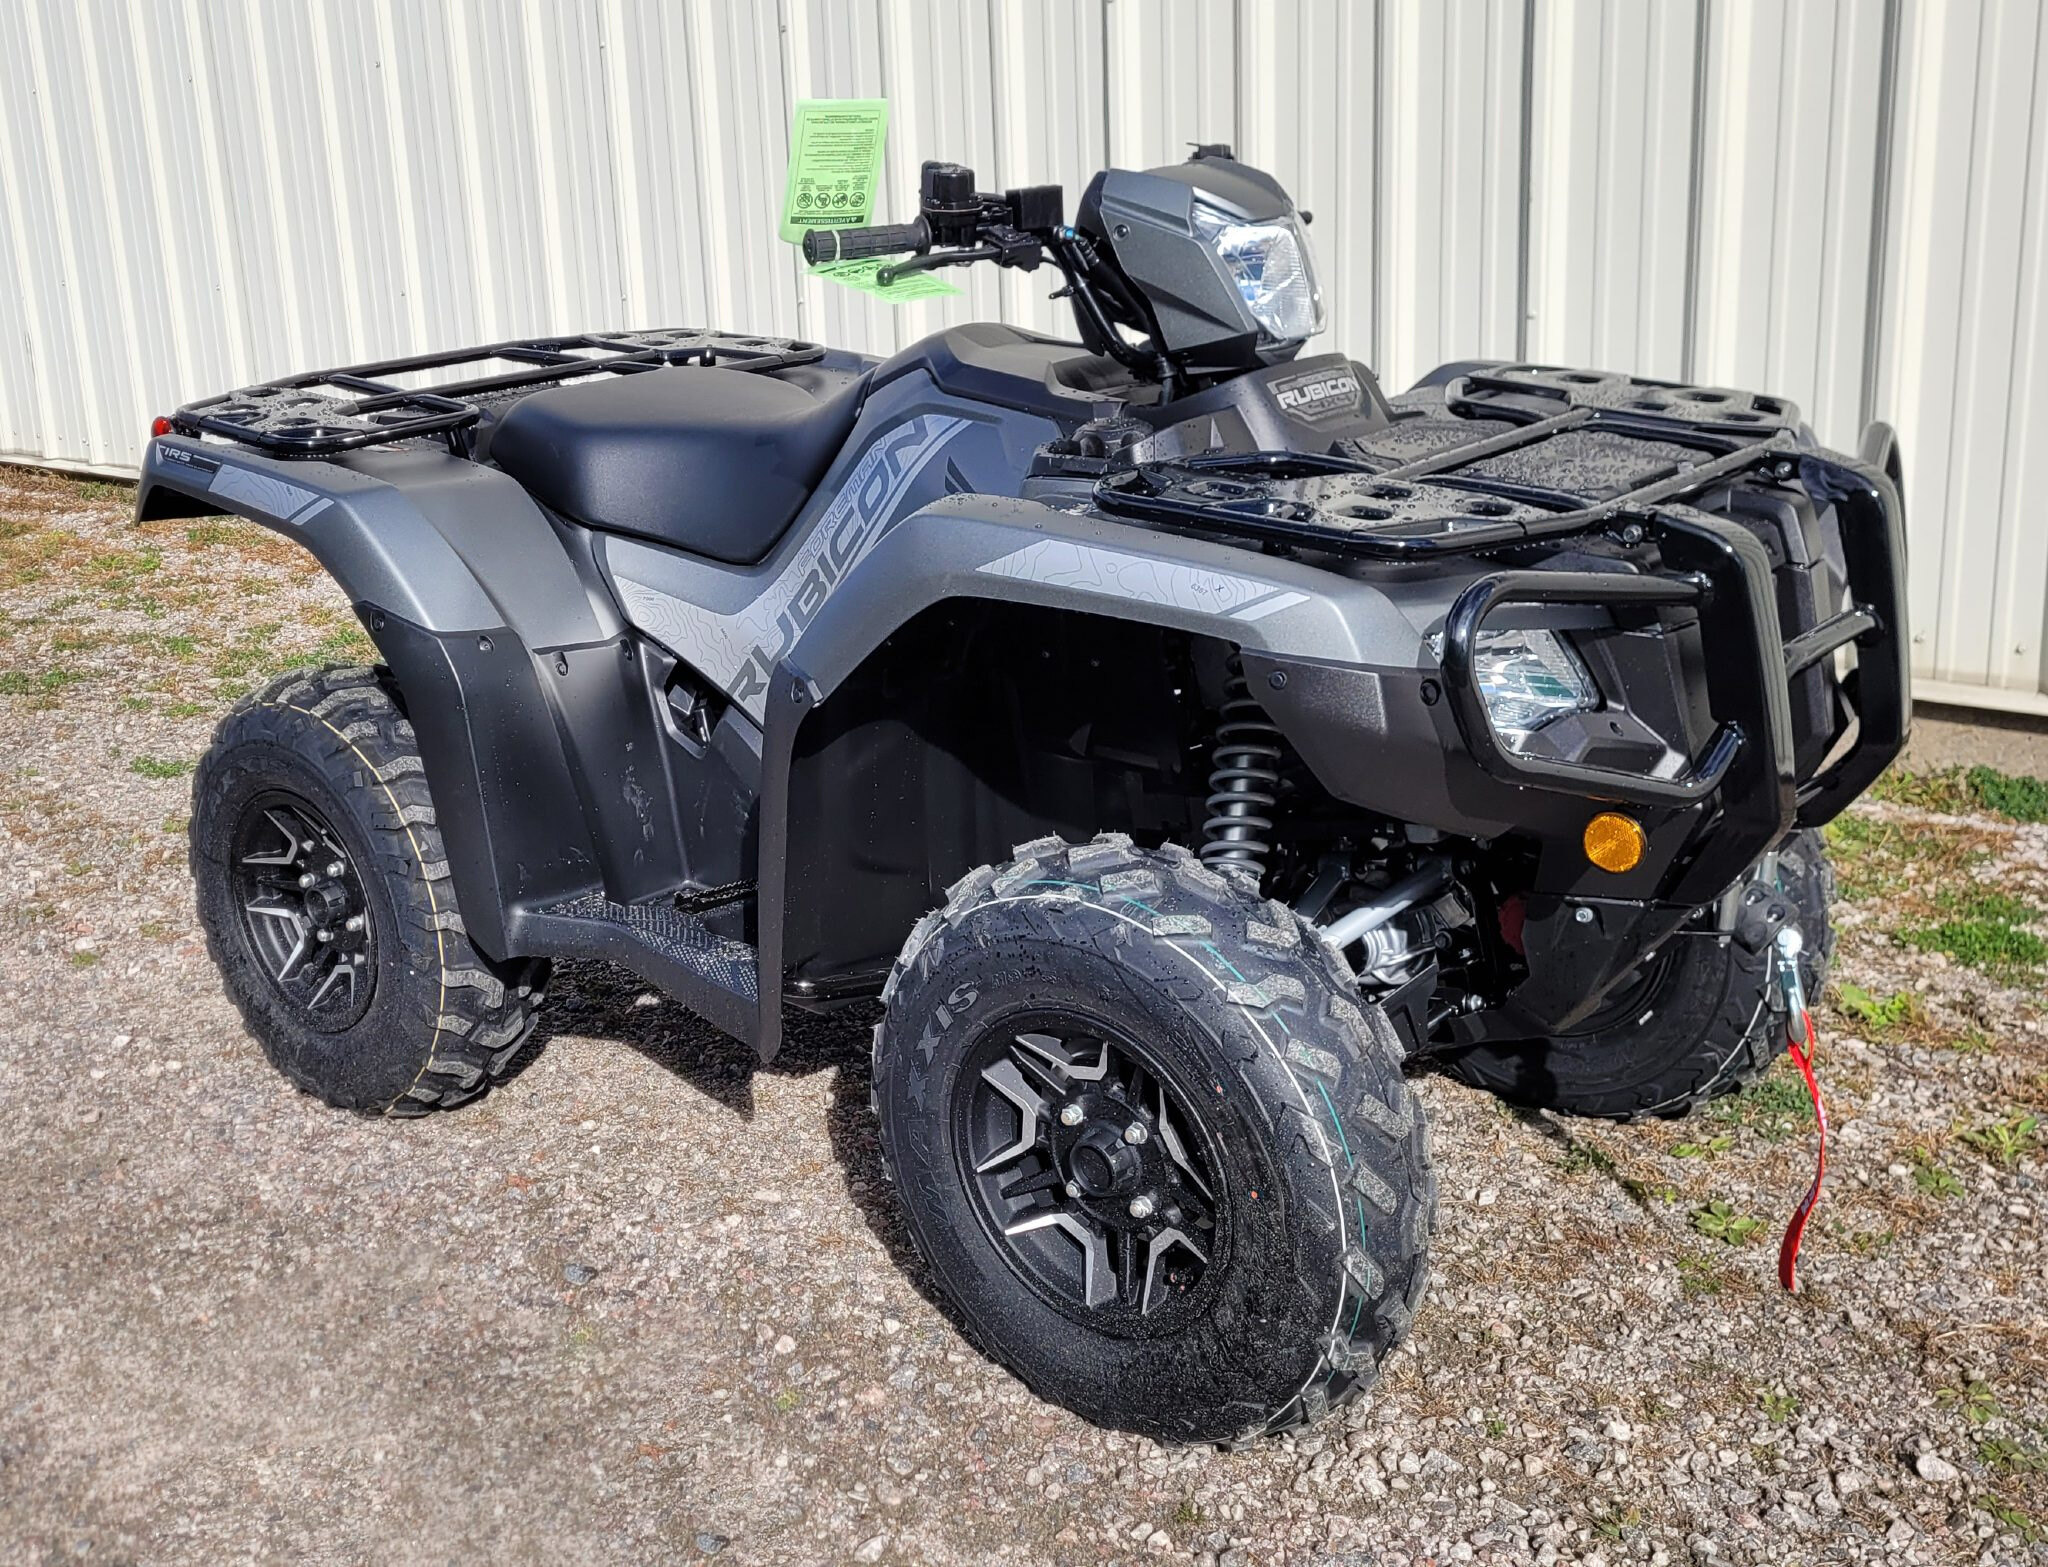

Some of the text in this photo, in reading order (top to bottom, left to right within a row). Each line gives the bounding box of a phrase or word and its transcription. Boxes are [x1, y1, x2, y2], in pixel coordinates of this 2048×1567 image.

[165, 446, 192, 463] IRS
[1276, 376, 1361, 410] RUBICON
[727, 416, 929, 703] RUBICON
[797, 437, 886, 577] FOREMAN
[907, 981, 980, 1226] MAXXIS
